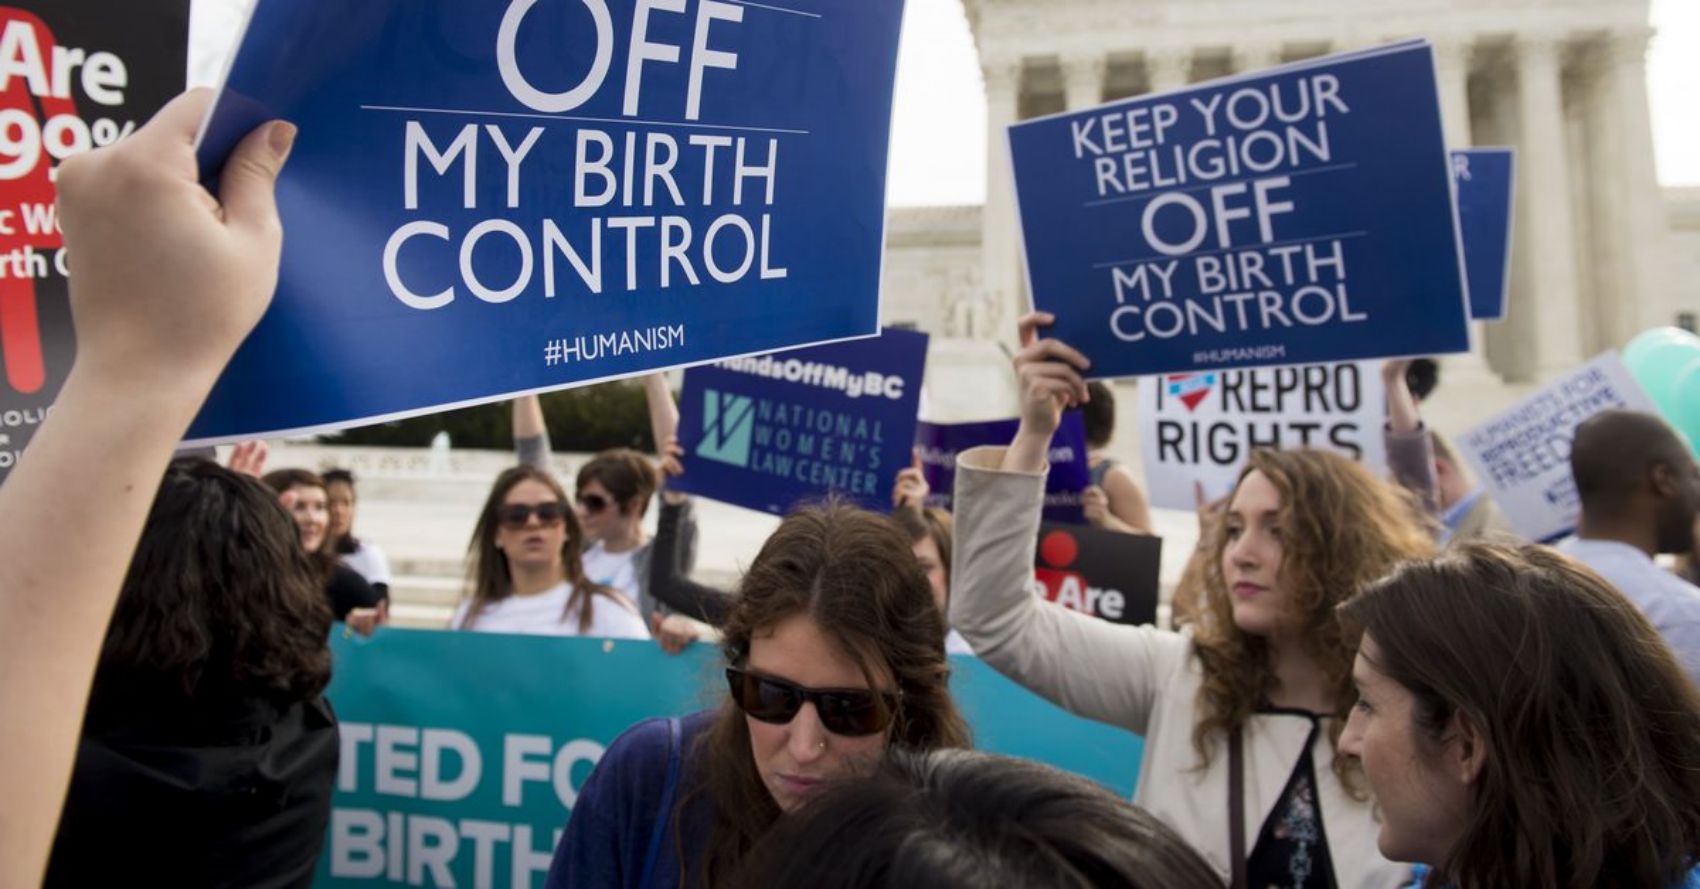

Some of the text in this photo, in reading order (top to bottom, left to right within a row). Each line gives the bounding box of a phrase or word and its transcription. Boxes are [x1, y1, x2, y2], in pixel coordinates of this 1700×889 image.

[0, 19, 128, 106] Are
[496, 0, 744, 120] OFF
[1071, 74, 1350, 158] KEEP YOUR
[404, 120, 778, 210] MY BIRTH
[1095, 120, 1330, 195] RELIGION
[1141, 176, 1294, 256] OFF
[383, 213, 787, 310] CONTROL
[1112, 240, 1346, 303] MY BIRTH
[1109, 283, 1368, 342] CONTROL
[545, 324, 685, 366] #HUMANISM
[1192, 344, 1286, 363] #HUMANISM
[1221, 363, 1361, 413] REPRO
[754, 423, 881, 470] WOMEN'S
[757, 398, 884, 444] NATIONAL
[1156, 420, 1363, 466] RIGHTS
[751, 450, 878, 495] LAW CENTER
[1055, 575, 1126, 618] Are
[337, 720, 483, 801] TED
